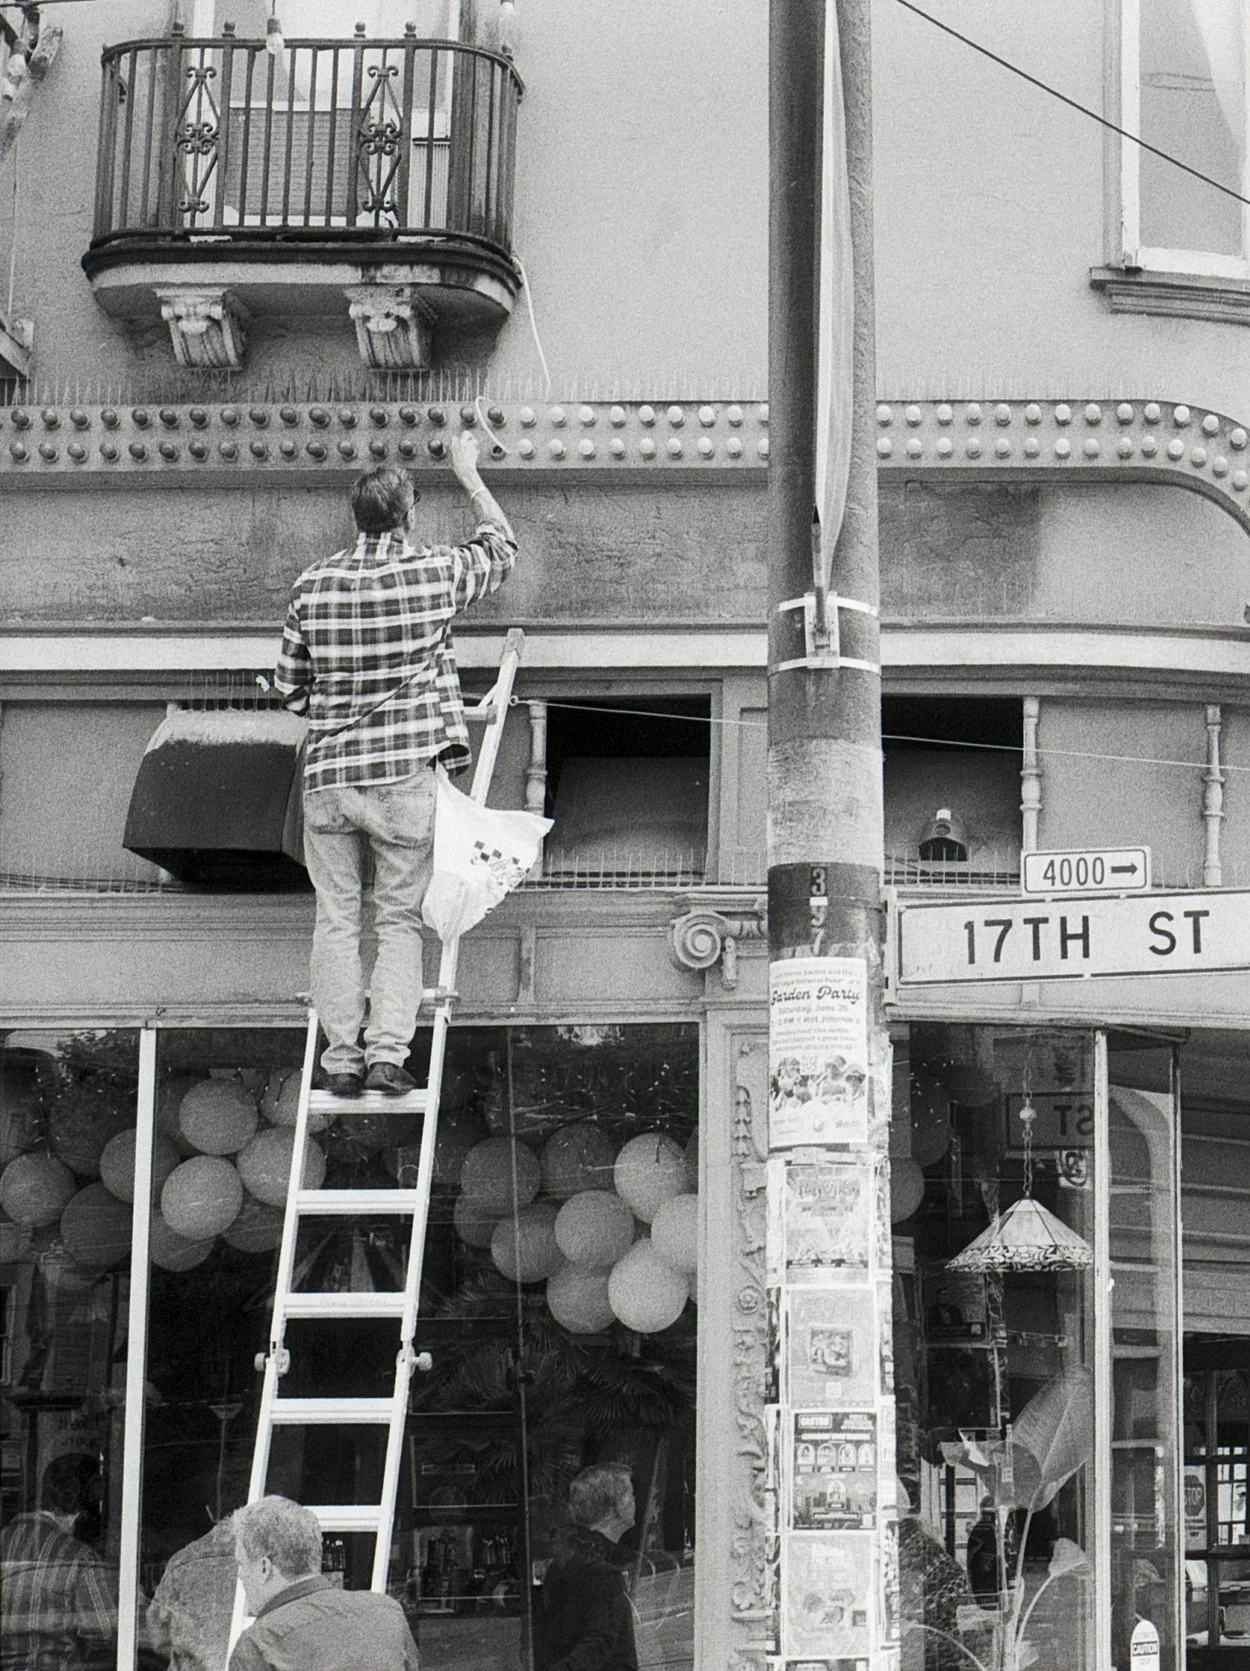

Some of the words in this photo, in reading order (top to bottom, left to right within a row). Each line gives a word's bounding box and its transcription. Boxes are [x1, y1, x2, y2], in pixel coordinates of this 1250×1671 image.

[1043, 857, 1105, 886] 4000
[964, 915, 1090, 965] 17TH
[1148, 910, 1210, 956] ST
[816, 985, 861, 1005] Party
